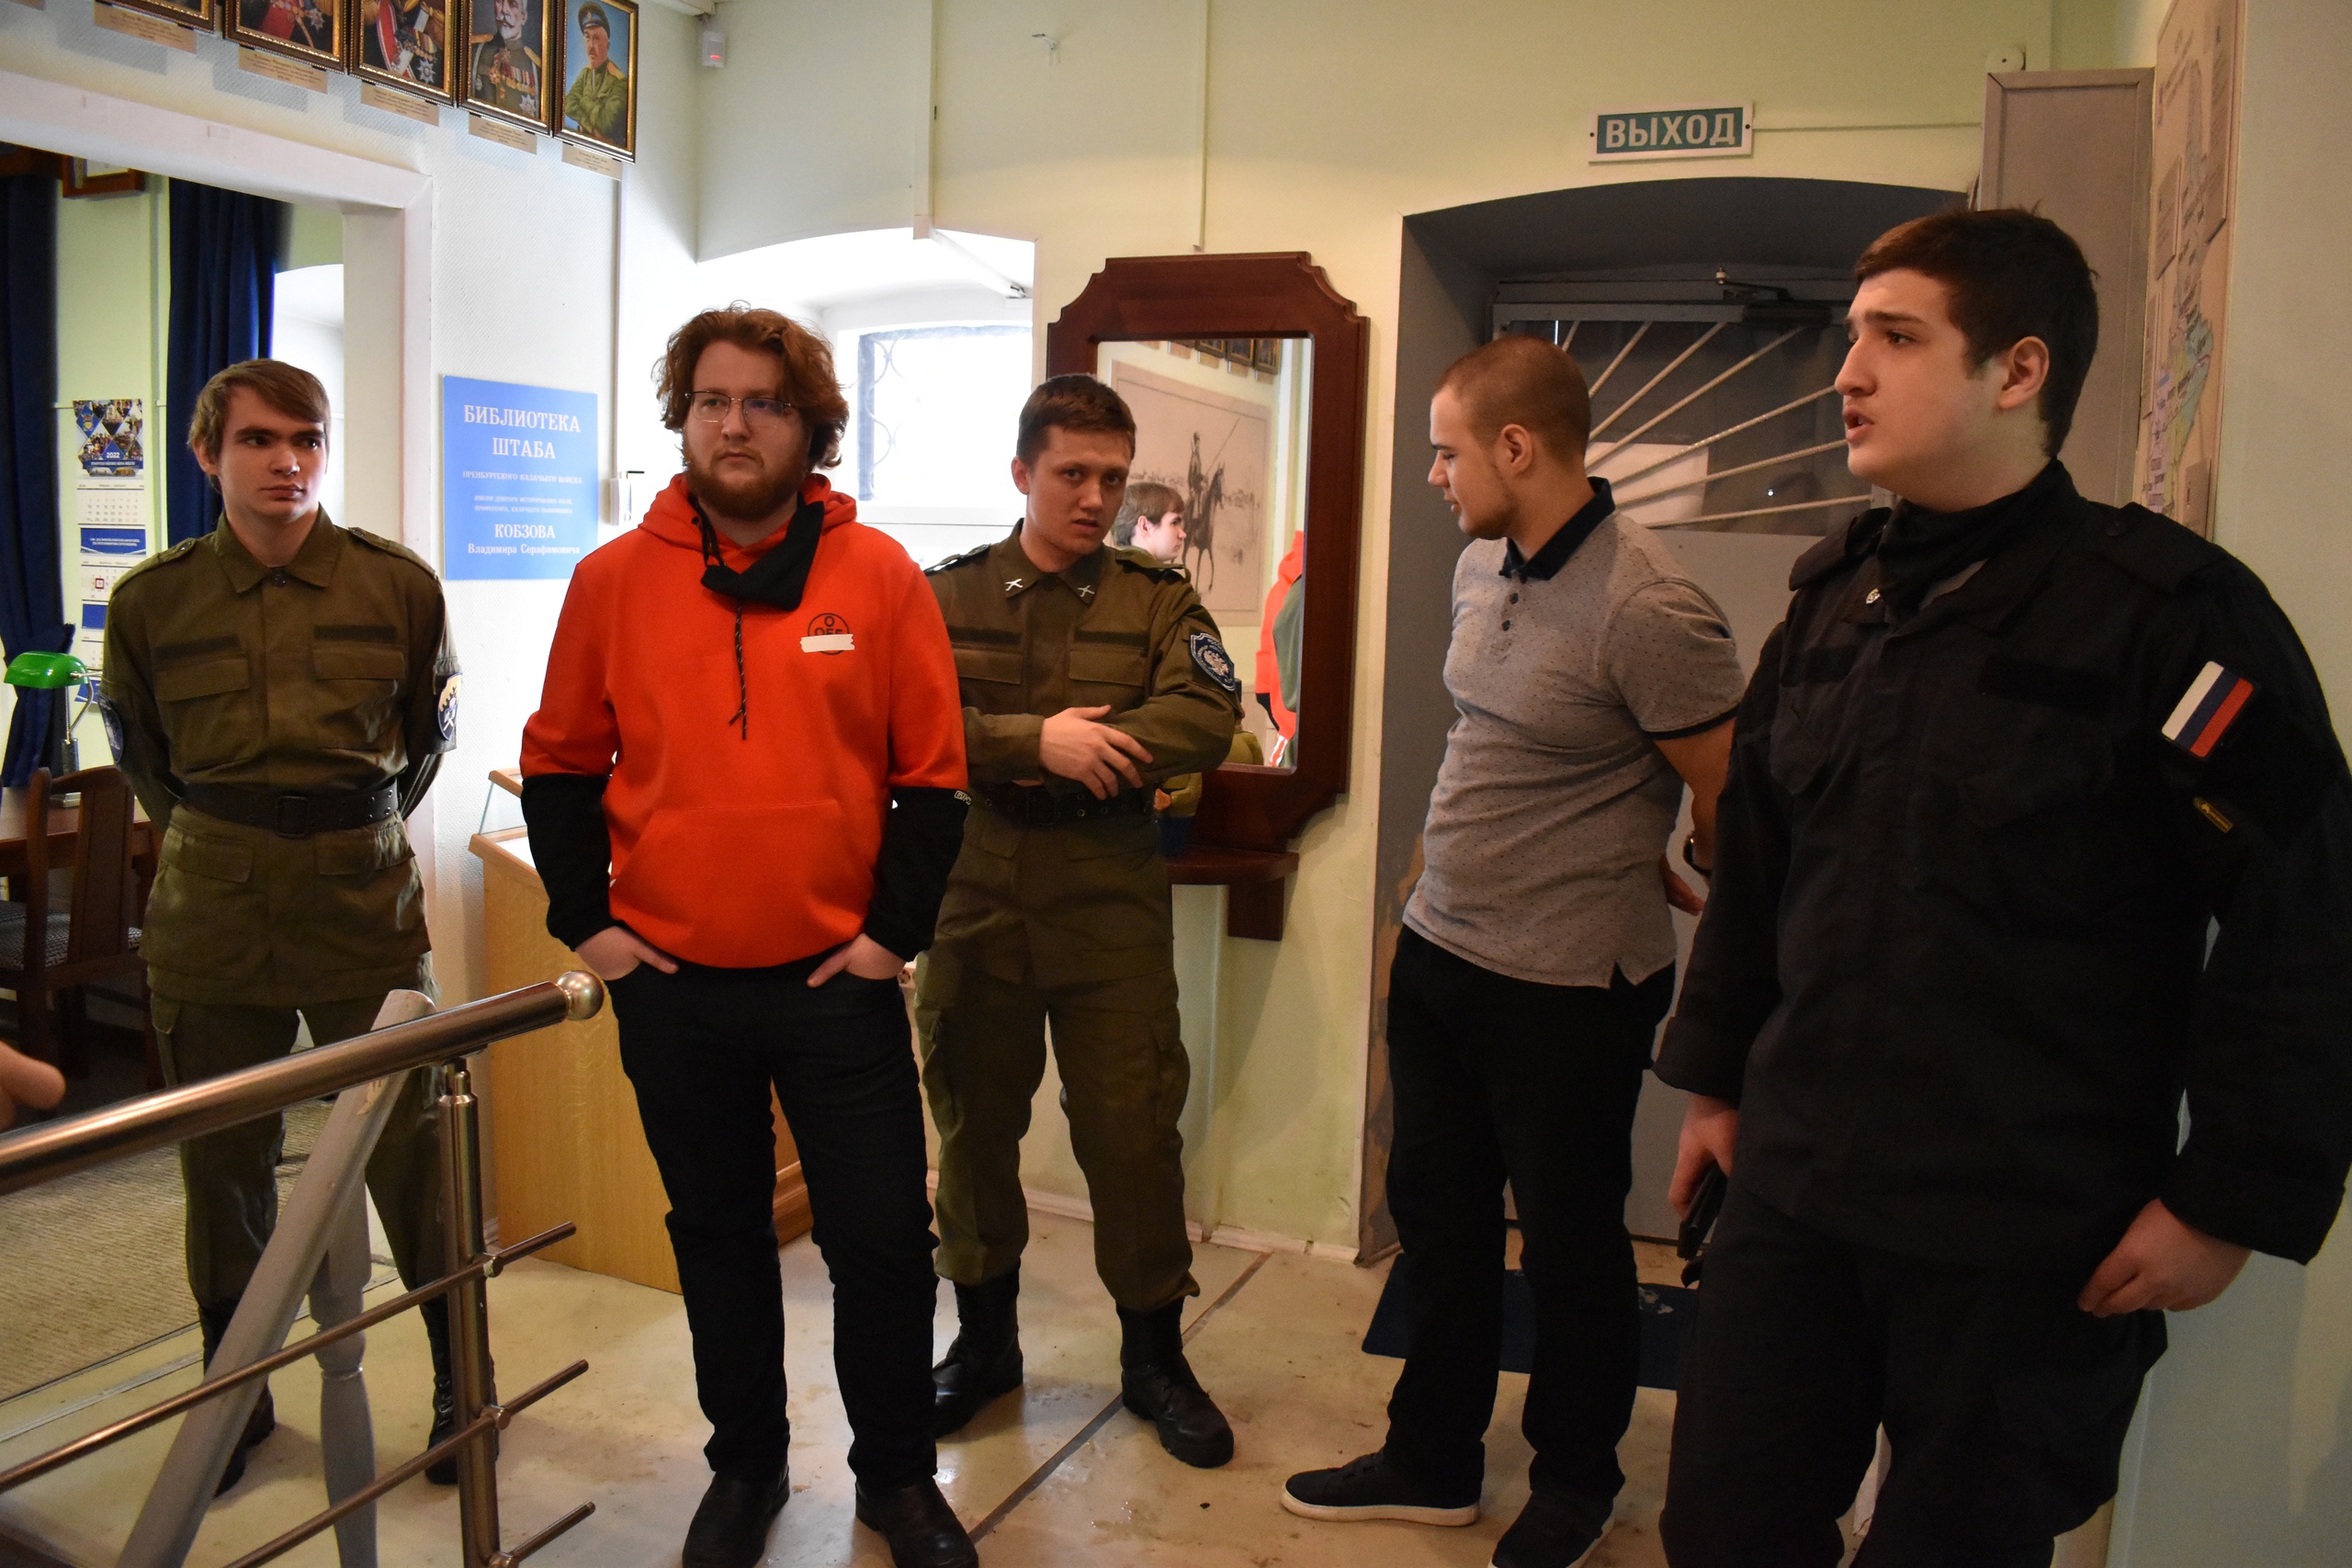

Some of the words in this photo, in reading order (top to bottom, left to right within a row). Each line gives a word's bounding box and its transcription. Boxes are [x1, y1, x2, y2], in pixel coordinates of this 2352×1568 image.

[1605, 112, 1736, 148] ВЫХОД
[464, 404, 581, 433] БИБЛИОТЕКА
[492, 437, 556, 459] ШТАБА
[462, 470, 518, 480] ОРЕНБУРГСКОГО
[520, 474, 557, 483] КАЗАЧЬЕГО
[494, 524, 556, 539] КОБЗОВА
[468, 543, 517, 555] Владимира
[520, 543, 580, 556] Серафимовича
